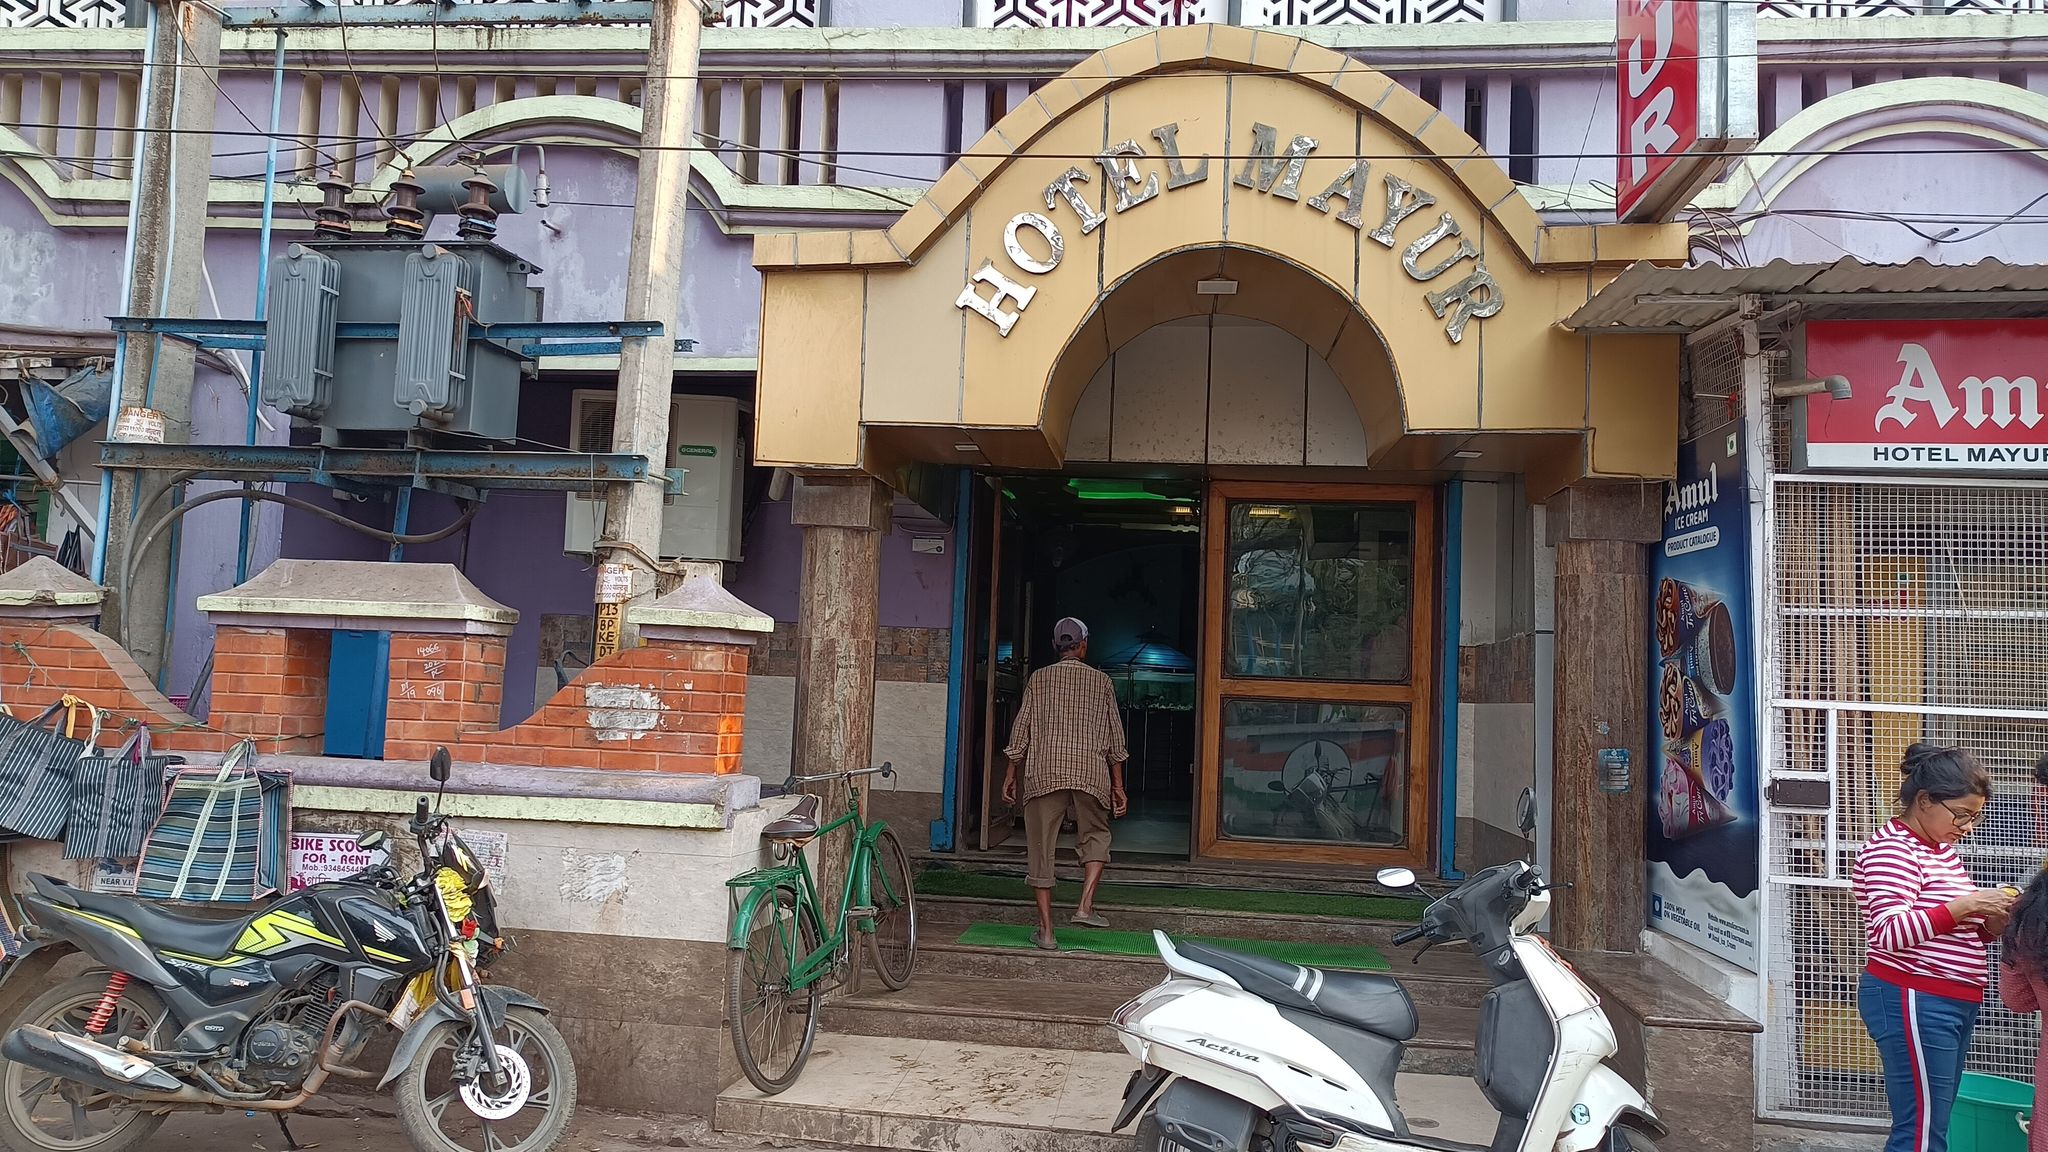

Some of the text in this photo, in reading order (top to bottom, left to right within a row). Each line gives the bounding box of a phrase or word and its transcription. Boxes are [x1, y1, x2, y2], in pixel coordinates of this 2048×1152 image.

[1629, 0, 1680, 187] UR
[955, 121, 1505, 345] HOTEL MAYUR
[1874, 343, 2048, 433] Am
[122, 407, 159, 420] DANGER
[1873, 446, 1959, 462] HOTEL
[1664, 462, 1719, 522] Amul
[1674, 508, 1709, 531] ICE CREAM
[1667, 530, 1717, 553] PRODUCT CATALOGUE
[599, 604, 619, 616] P13
[599, 619, 614, 631] BP
[598, 631, 615, 643] KE
[292, 837, 324, 851] BIKE
[302, 853, 327, 864] FOR
[340, 854, 372, 866] RENT
[100, 878, 120, 886] NEAR
[1675, 906, 1686, 916] MILK
[1671, 914, 1693, 928] VEGETABLE
[1693, 921, 1701, 932] OIL
[1185, 1038, 1260, 1063] Activa
